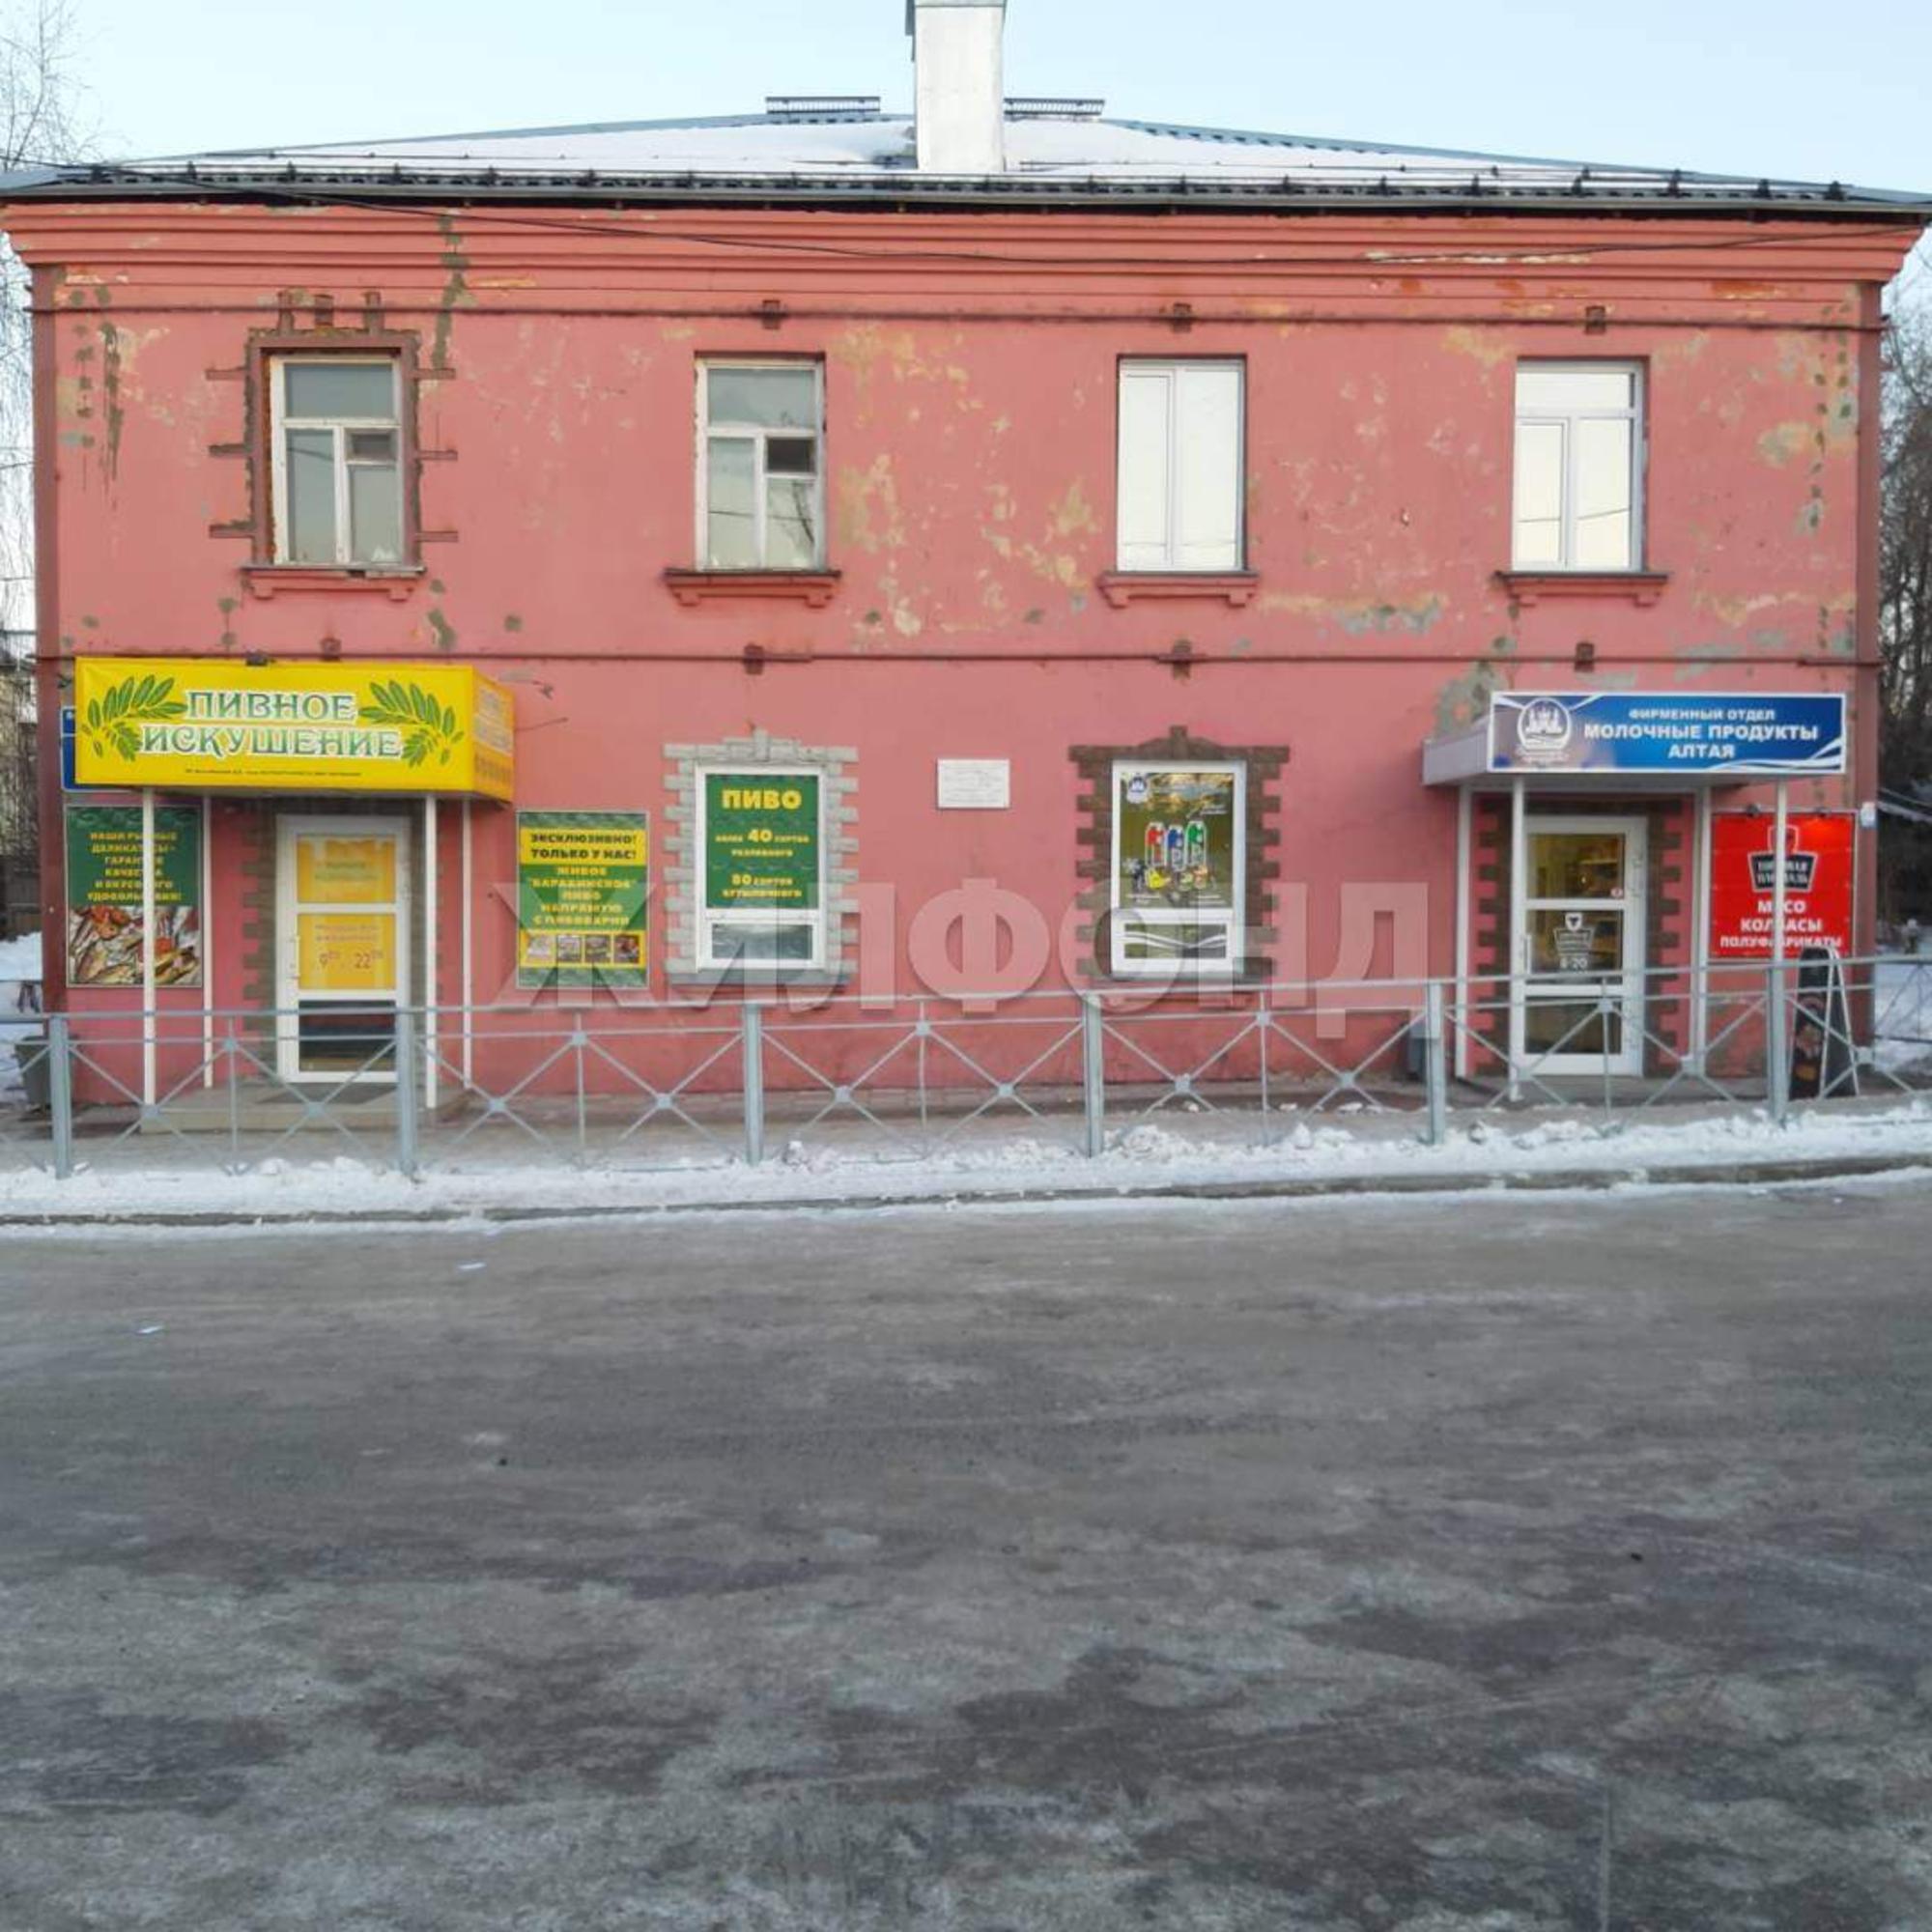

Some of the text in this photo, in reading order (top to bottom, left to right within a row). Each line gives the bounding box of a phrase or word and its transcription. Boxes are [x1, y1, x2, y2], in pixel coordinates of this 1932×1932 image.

[187, 691, 356, 722] ПИВНОЕ
[1629, 708, 1776, 722] ФИРМЕННЫЙ ОТДЕЛ
[142, 724, 402, 757] ИСКУШЕНИЕ
[1584, 724, 1819, 742] МОЛОЧНЫЕ ПРОДУКТЫ
[1667, 743, 1736, 758] АЛТАЯ
[721, 789, 802, 810] ПИВО
[747, 828, 773, 843] 40
[531, 849, 637, 860] ТОЛЬКО У НАС!
[1758, 899, 1806, 914] МСО
[1741, 919, 1823, 932] КОЛАСЫ
